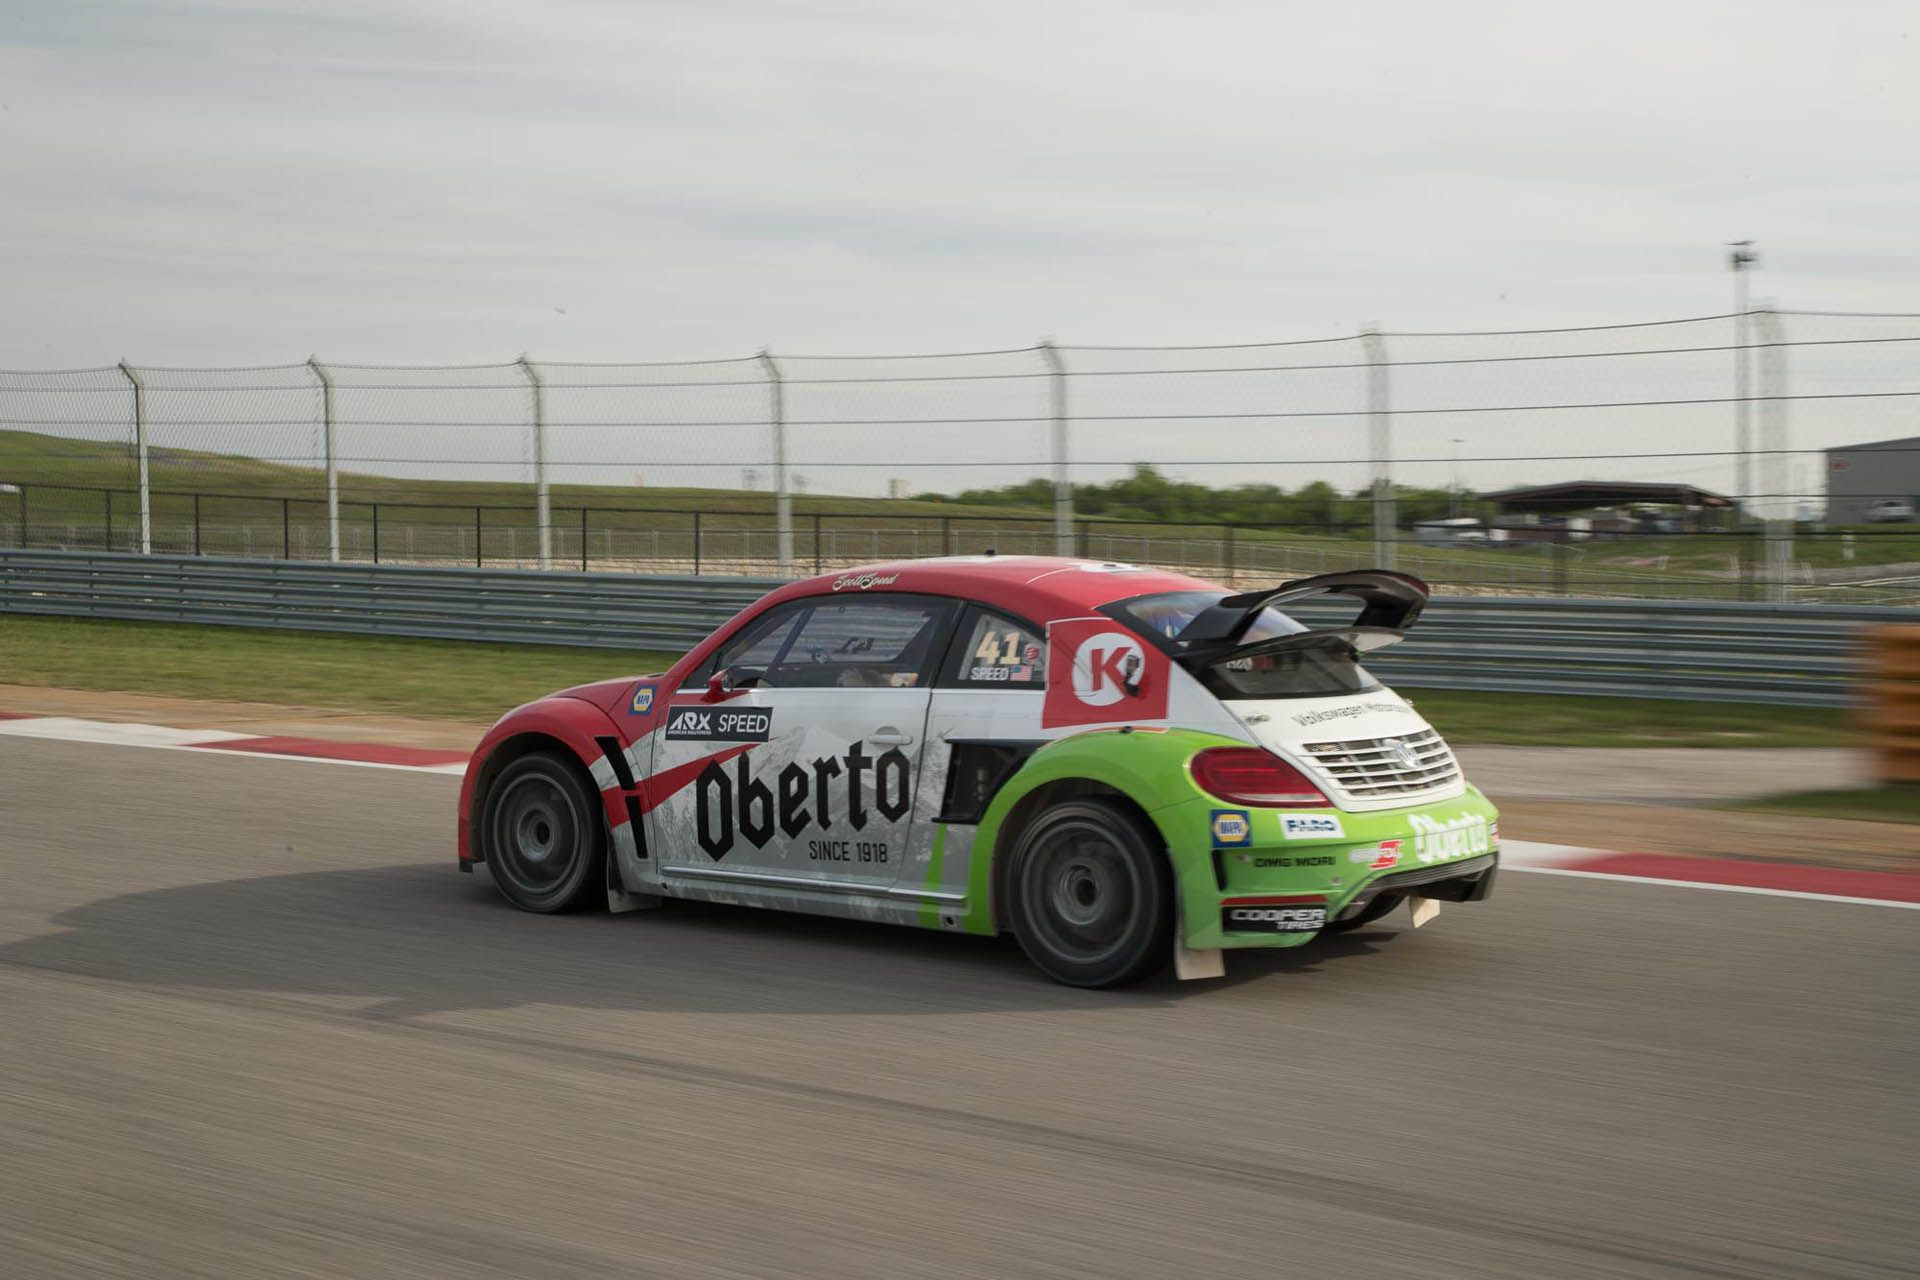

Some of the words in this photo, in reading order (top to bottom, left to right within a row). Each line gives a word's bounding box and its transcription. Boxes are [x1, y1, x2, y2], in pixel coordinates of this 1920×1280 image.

[975, 631, 1021, 665] 41
[970, 667, 1009, 681] SPEED
[1091, 646, 1134, 697] K
[636, 693, 651, 705] NAPA
[669, 711, 712, 730] ARX
[717, 714, 770, 734] SPEED
[696, 740, 910, 862] Oberto
[809, 840, 851, 861] SINCE
[856, 842, 888, 863] 1918
[1230, 908, 1327, 921] COOPER
[1275, 919, 1325, 930] TIRES
